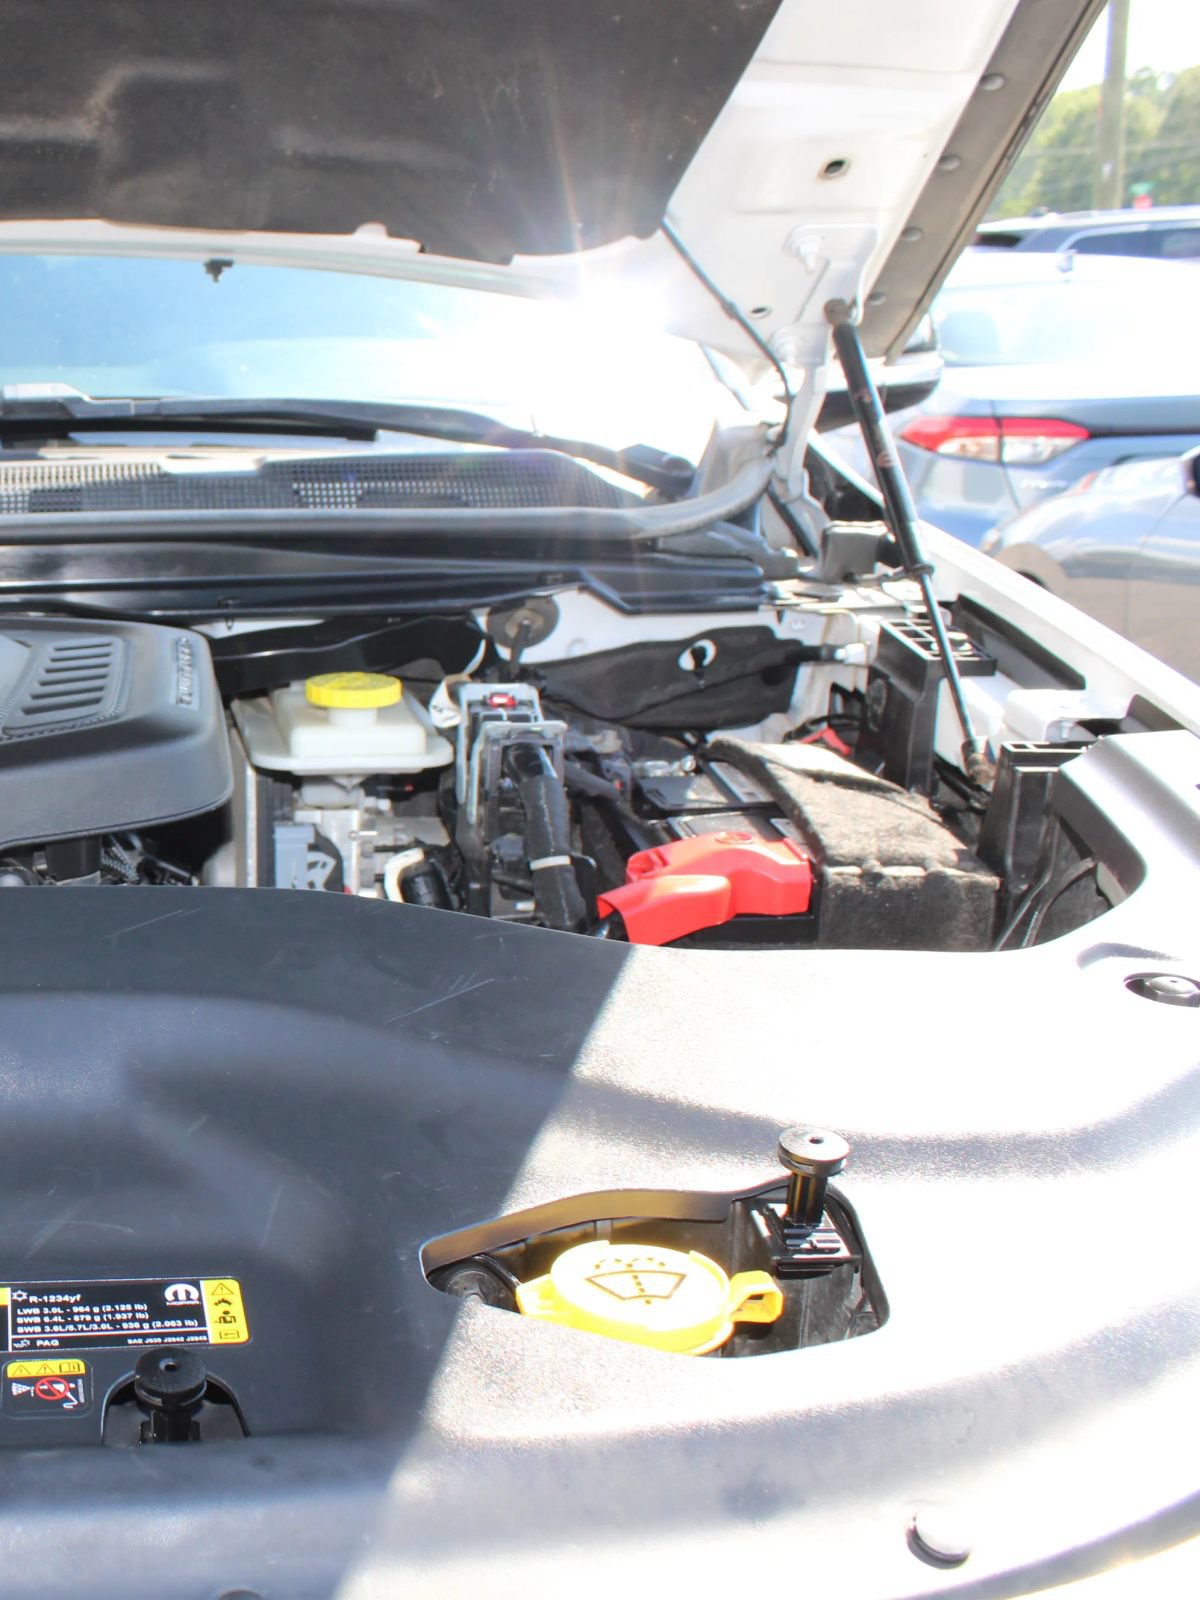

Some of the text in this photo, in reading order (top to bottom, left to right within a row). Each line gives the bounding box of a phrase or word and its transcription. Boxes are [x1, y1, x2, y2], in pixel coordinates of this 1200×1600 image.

[28, 1293, 82, 1304] R-1234yf
[16, 1307, 41, 1315] LWB
[16, 1316, 41, 1324] SWB
[16, 1325, 42, 1334] SWB
[36, 1339, 60, 1347] PAG
